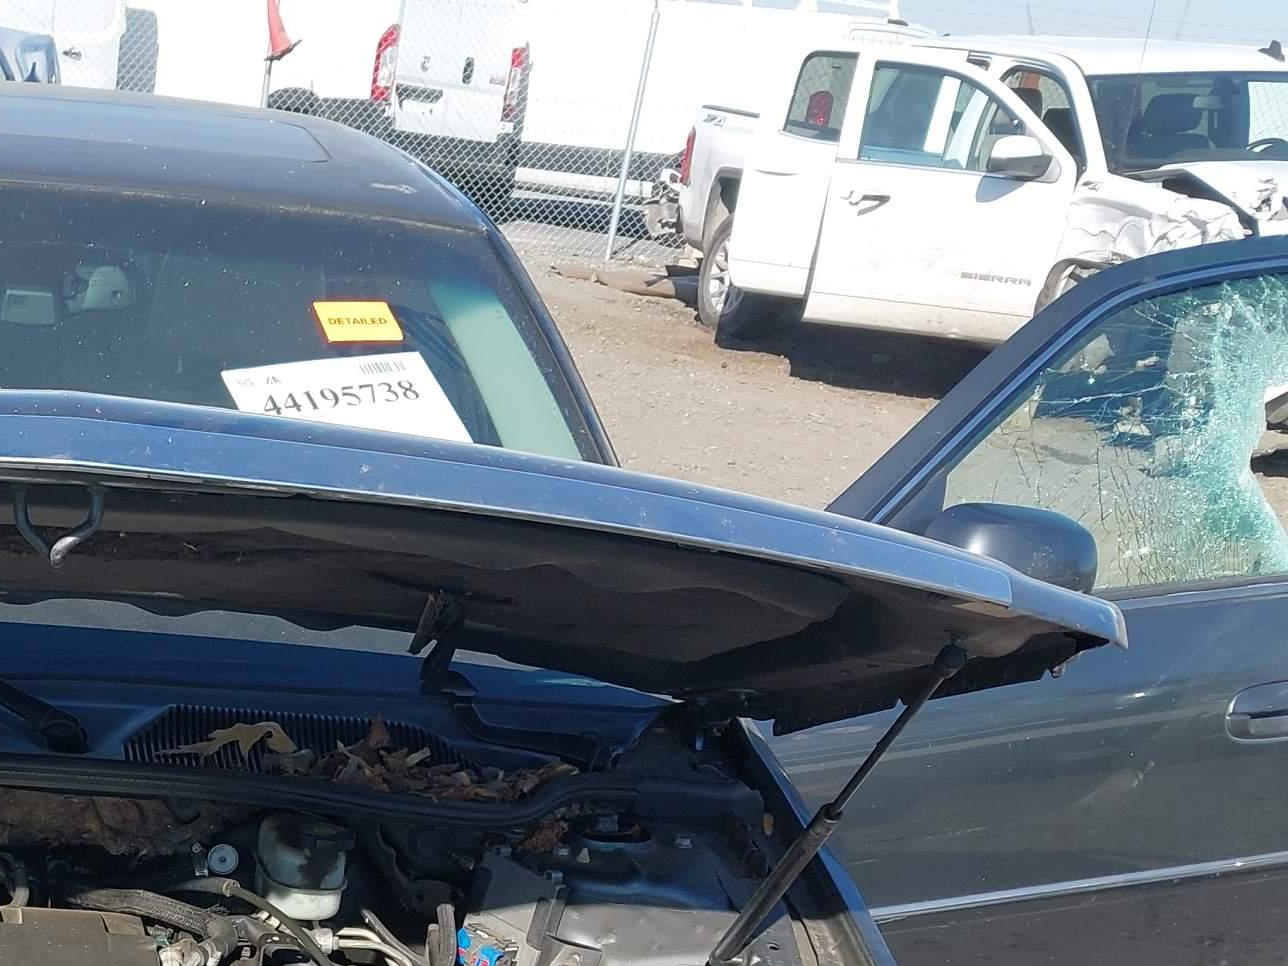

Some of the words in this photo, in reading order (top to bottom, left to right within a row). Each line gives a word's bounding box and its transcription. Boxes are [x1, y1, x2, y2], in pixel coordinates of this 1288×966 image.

[960, 271, 1032, 287] SIERRA
[327, 317, 388, 326] DETAILED
[264, 380, 420, 415] 44195738
